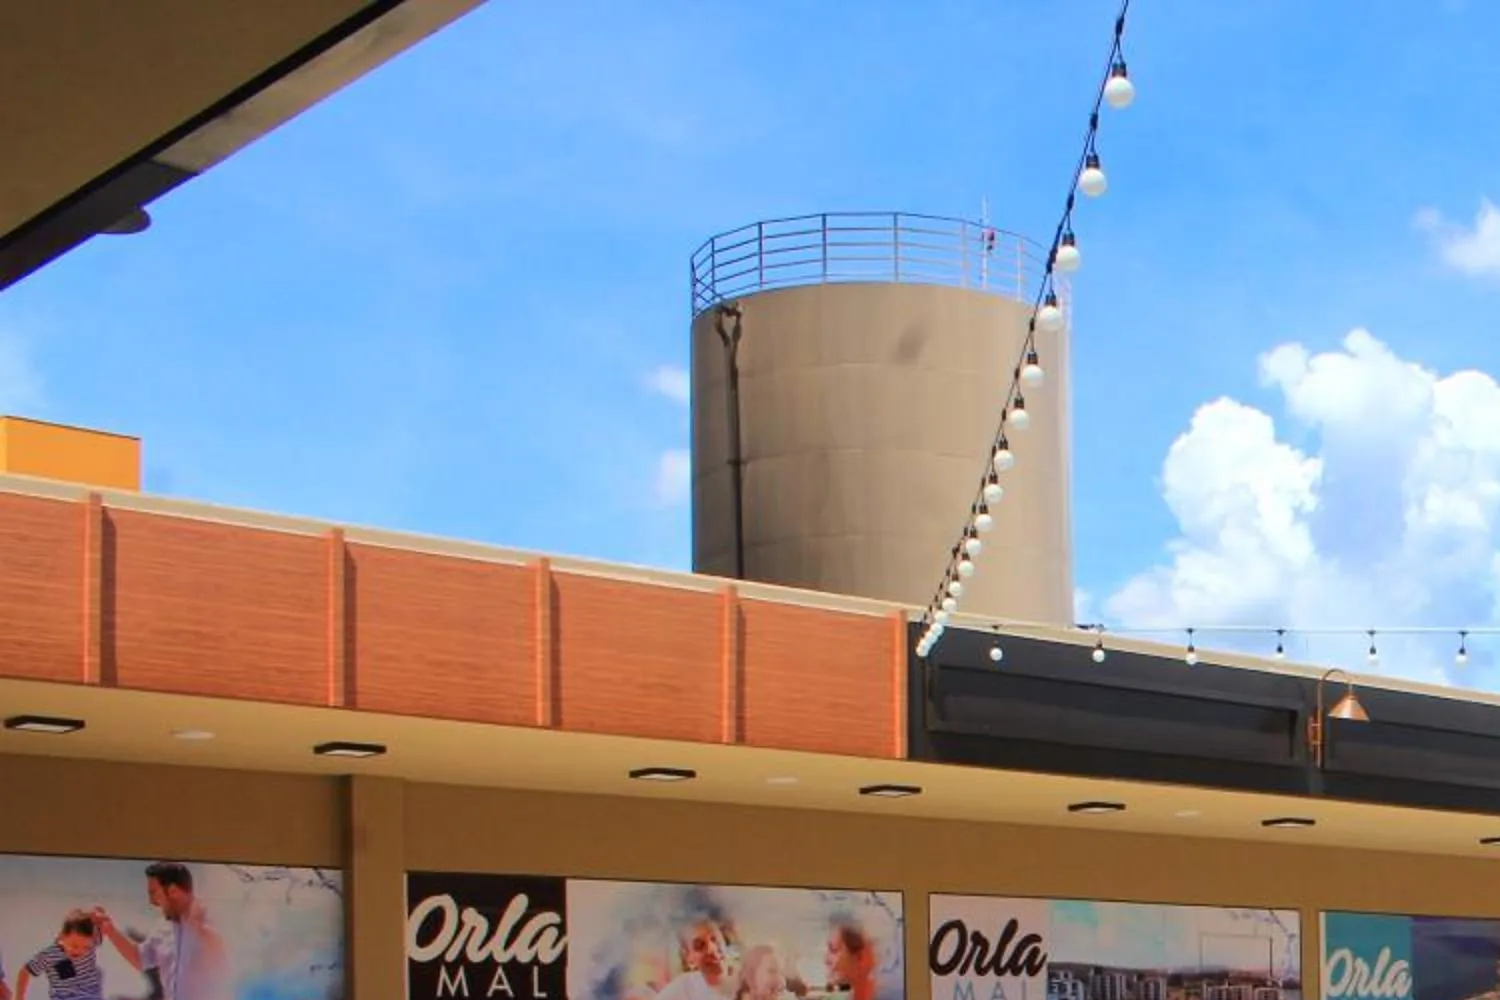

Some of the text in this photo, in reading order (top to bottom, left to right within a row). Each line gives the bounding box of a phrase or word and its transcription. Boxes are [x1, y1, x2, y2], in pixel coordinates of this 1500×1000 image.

[408, 893, 568, 964] Orla
[929, 918, 1048, 976] Orla
[1327, 946, 1412, 997] Orla
